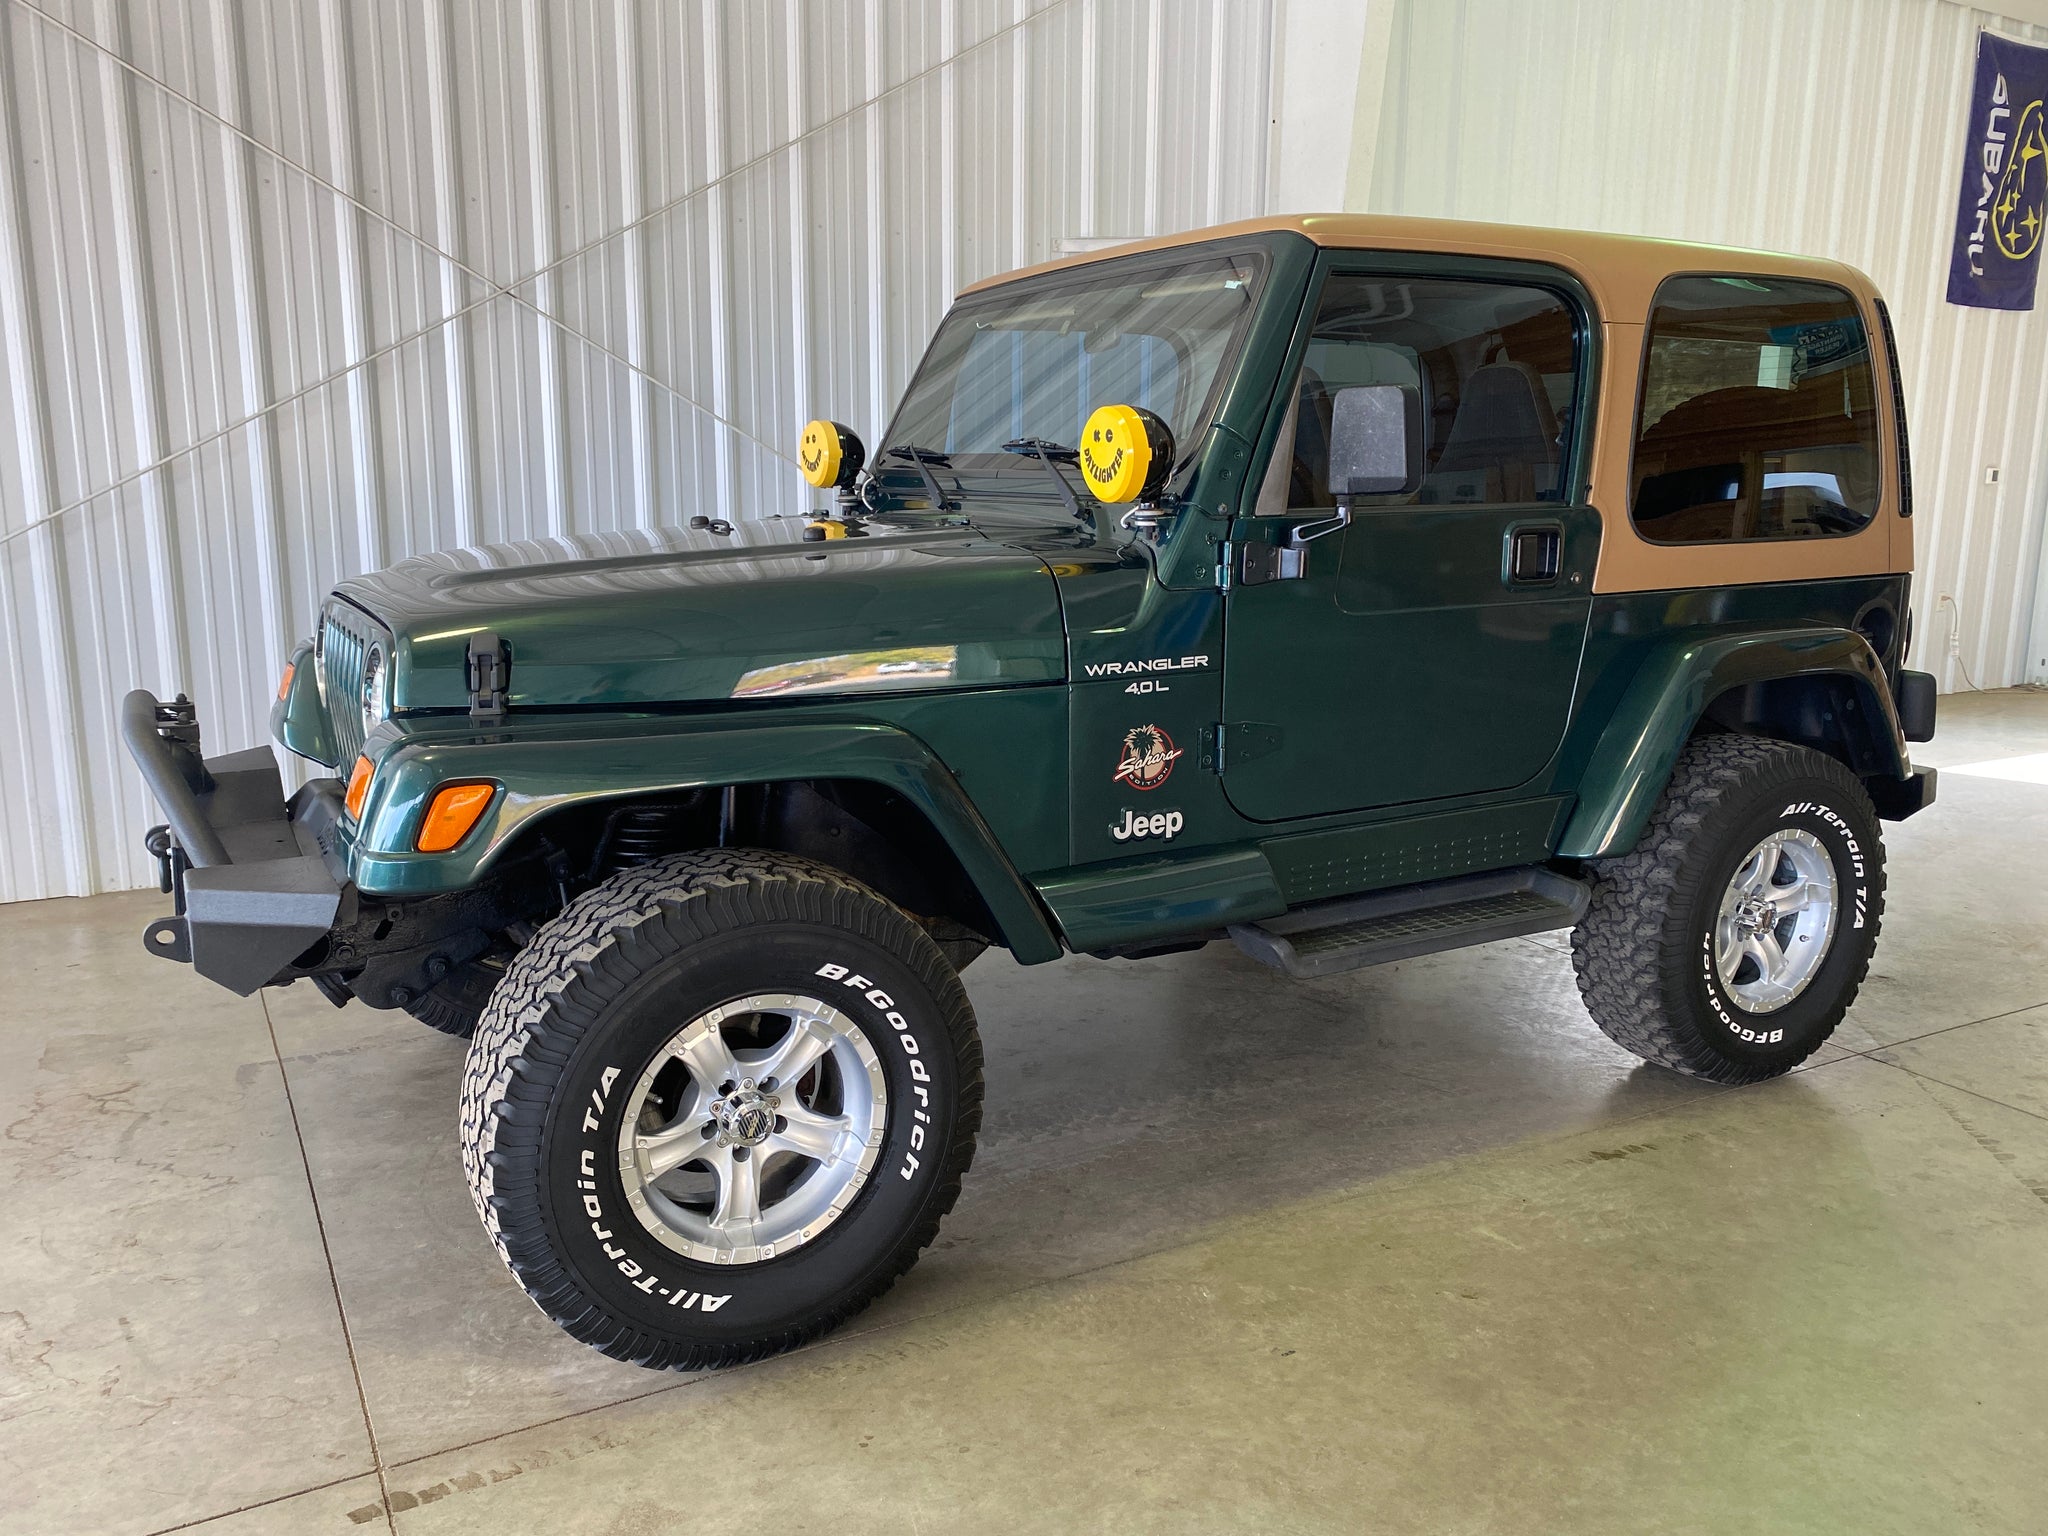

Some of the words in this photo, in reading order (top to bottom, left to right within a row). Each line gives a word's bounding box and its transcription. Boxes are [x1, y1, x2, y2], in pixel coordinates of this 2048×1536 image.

[1968, 72, 2010, 276] SUBARU
[1084, 447, 1123, 484] DAYLIGHTER
[1084, 655, 1209, 677] WRANGLER
[1114, 749, 1182, 780] Sahara
[1128, 767, 1169, 786] EDITION
[1111, 809, 1184, 841] Jeep
[1780, 802, 1865, 878] All-Terrain
[1853, 885, 1868, 929] T/A
[1703, 931, 1784, 1044] BFGoodrich
[582, 1065, 621, 1133] T/A
[814, 962, 932, 1181] BFGoodrich
[577, 1149, 733, 1312] All-Terrain
